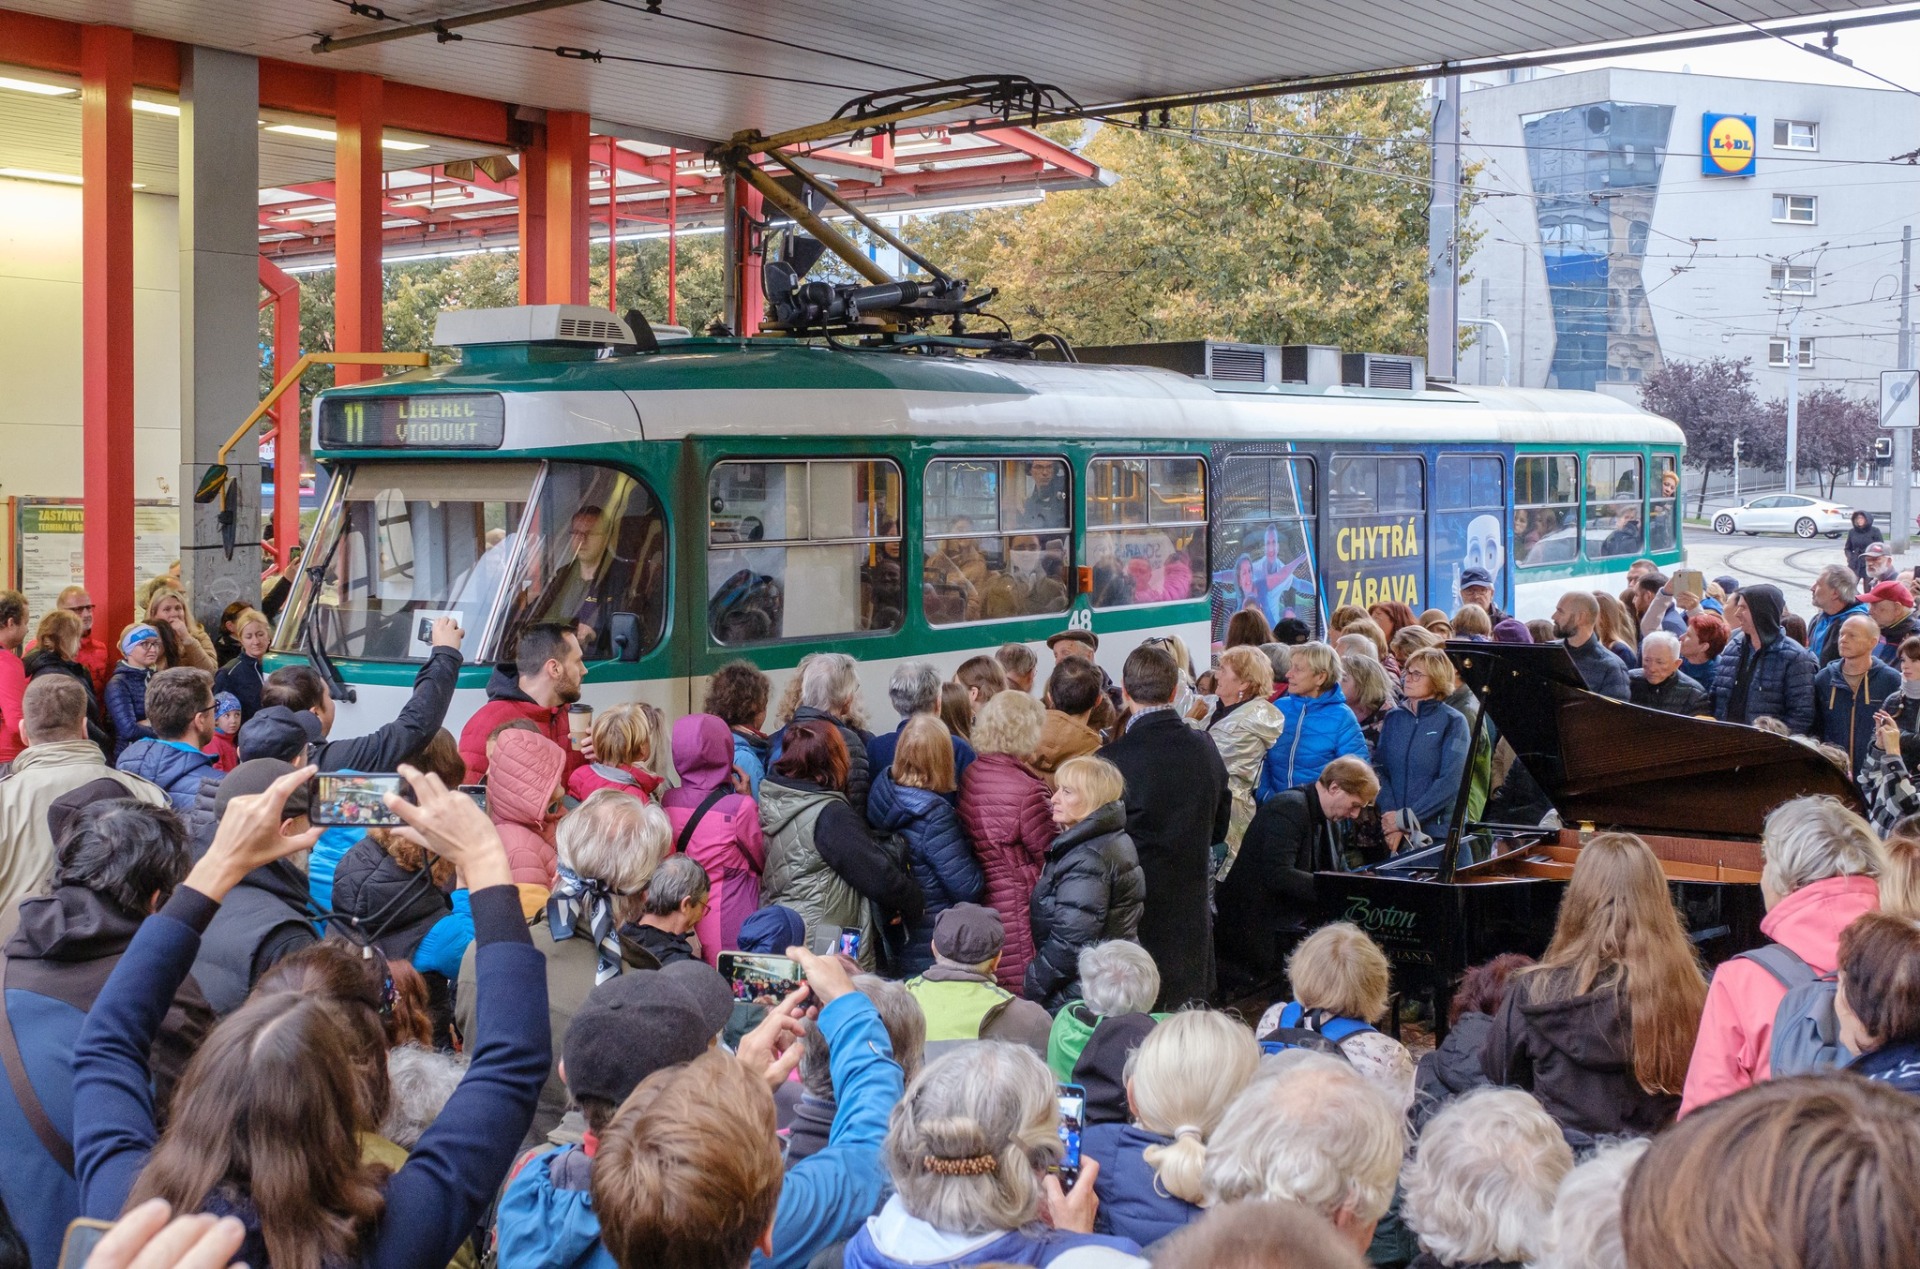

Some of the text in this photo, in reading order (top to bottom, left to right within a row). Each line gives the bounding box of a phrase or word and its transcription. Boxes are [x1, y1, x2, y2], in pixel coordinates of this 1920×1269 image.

[1713, 134, 1751, 151] LIDL
[344, 403, 364, 442] 11
[396, 423, 478, 442] VIADUKT
[1336, 516, 1418, 562] CHYTRÁ
[1336, 571, 1418, 612] ZÁBAVA
[1068, 609, 1092, 631] 48
[1345, 896, 1416, 930] Boston
